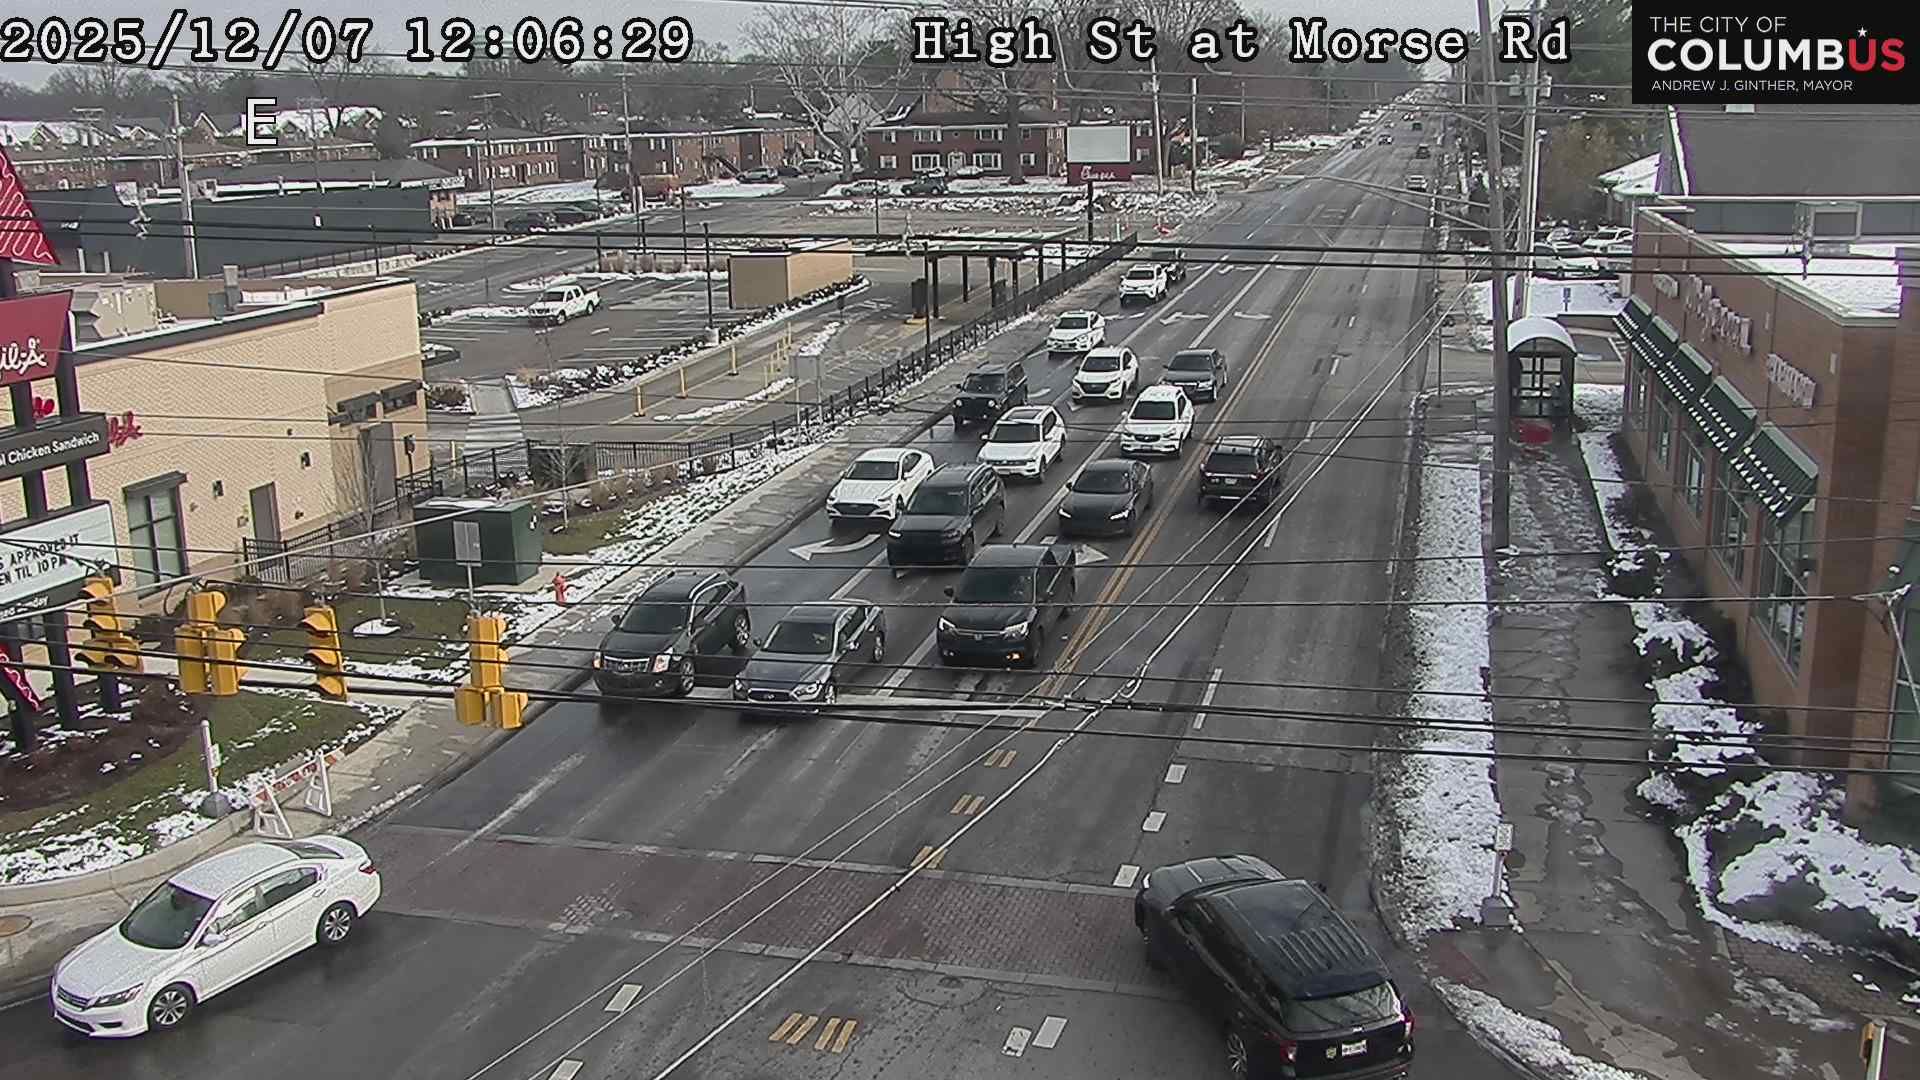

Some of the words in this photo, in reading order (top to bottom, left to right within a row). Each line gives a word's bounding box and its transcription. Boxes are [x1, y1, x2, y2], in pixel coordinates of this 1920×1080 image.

[8, 446, 51, 464] Chicken
[52, 432, 101, 454] Sandwich
[10, 538, 66, 566] APPROVED
[15, 566, 32, 581] TIL
